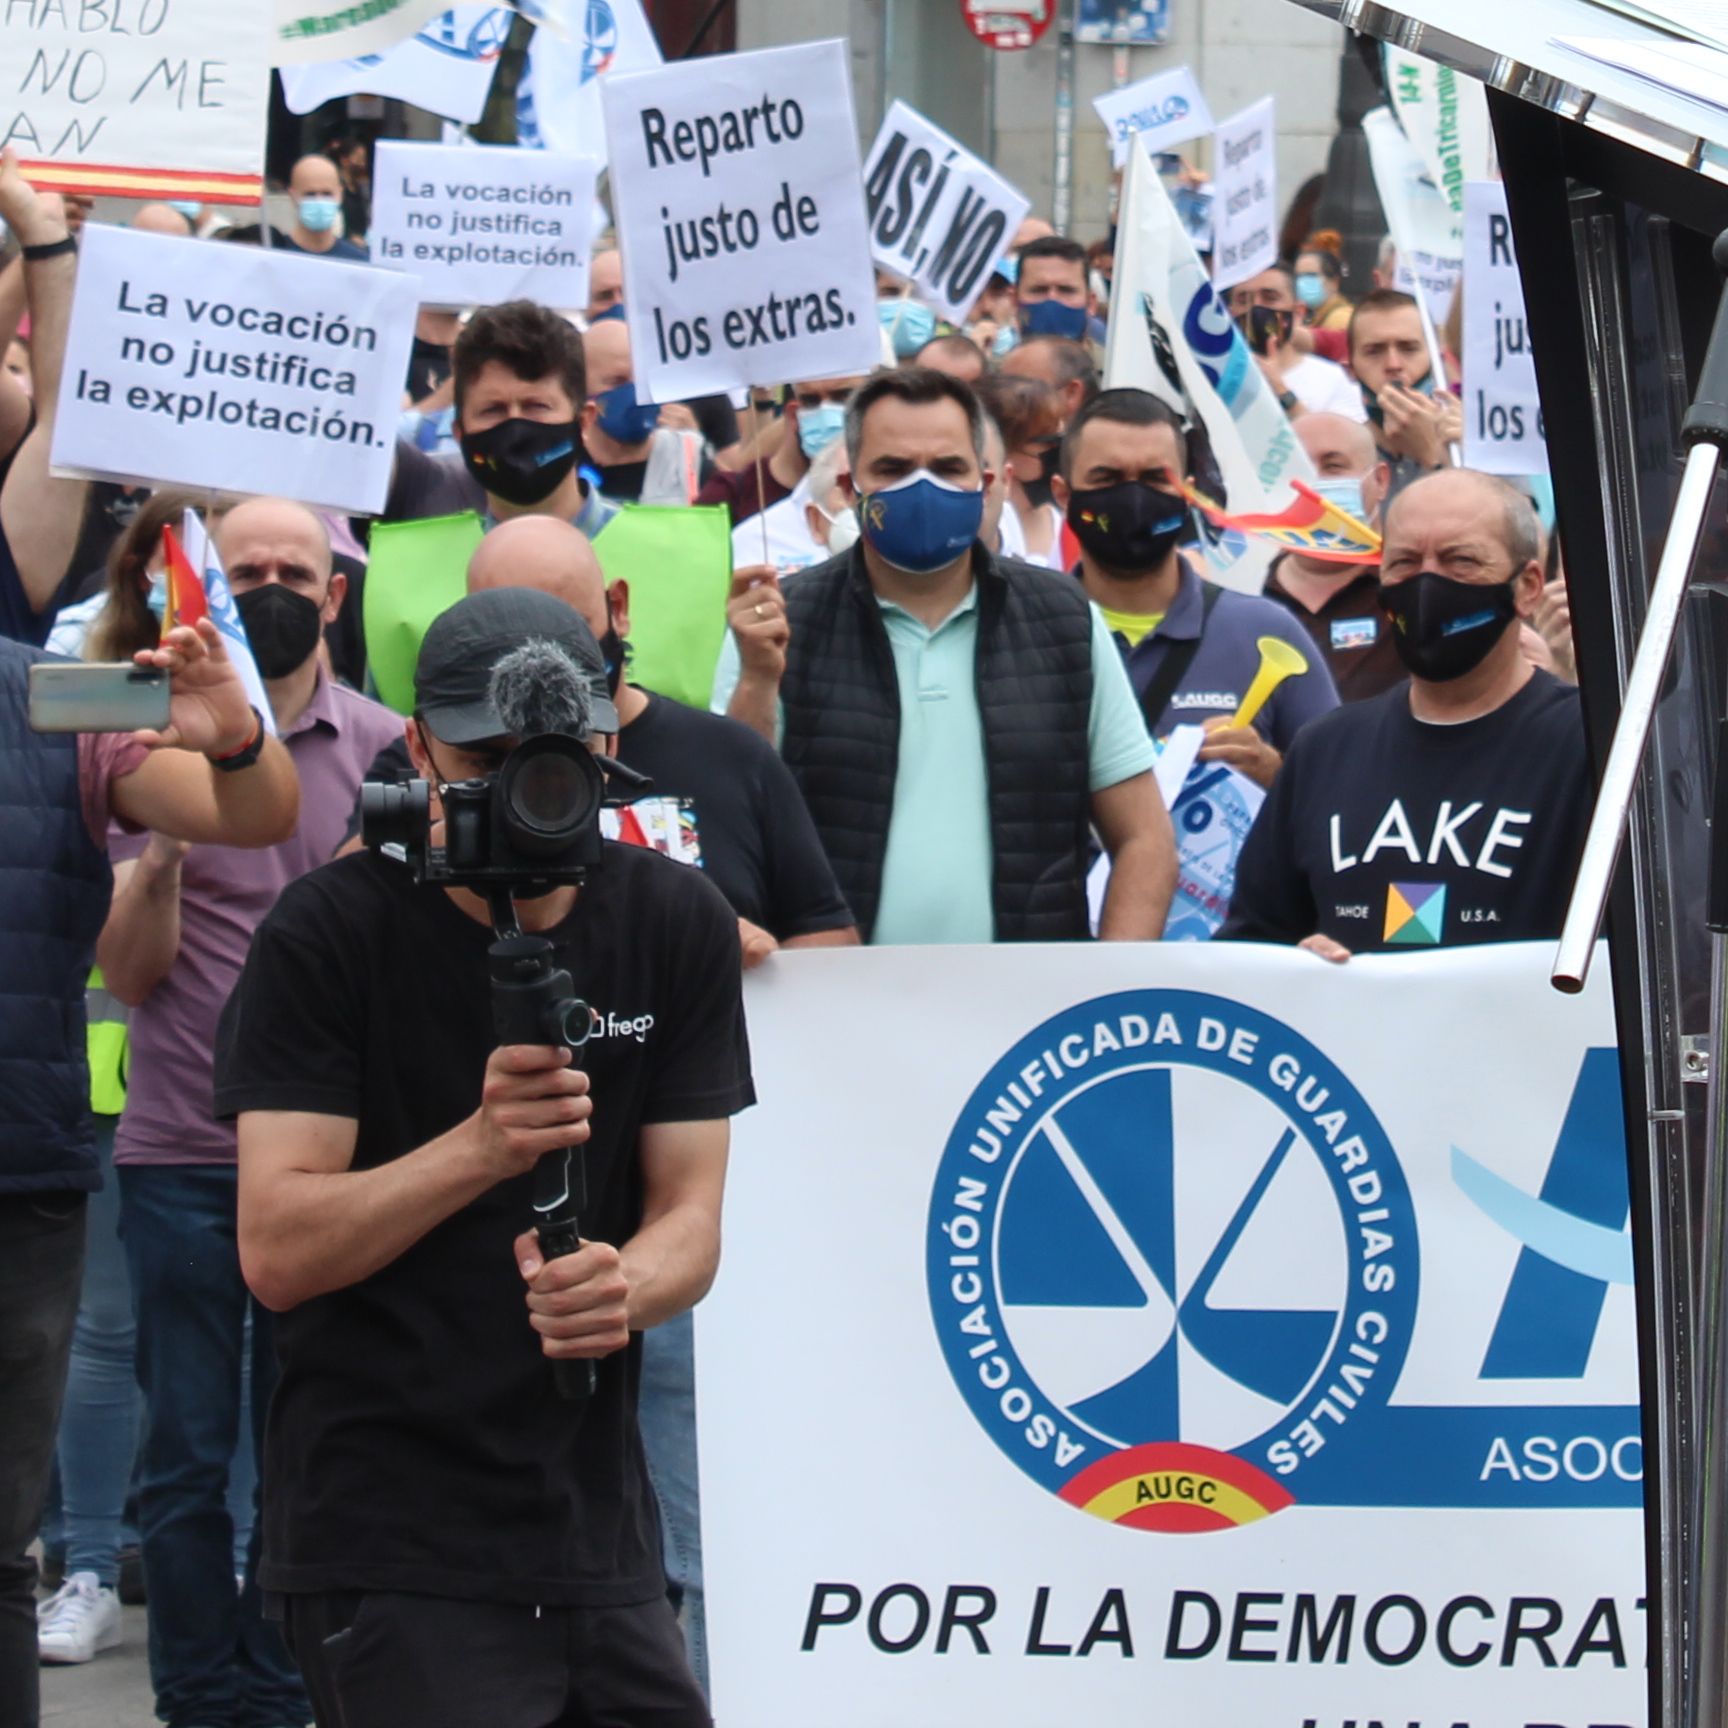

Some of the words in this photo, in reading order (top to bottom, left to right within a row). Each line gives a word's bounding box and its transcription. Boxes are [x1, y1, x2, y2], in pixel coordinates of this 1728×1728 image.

[18, 48, 106, 104] NO
[129, 58, 227, 110] ME
[643, 94, 805, 178] Reparto
[401, 175, 437, 200] La
[445, 177, 573, 206] vocación
[406, 213, 443, 231] no
[449, 209, 563, 240] justifica
[380, 237, 408, 259] la
[413, 237, 584, 270] explotación.
[660, 198, 761, 282] justo
[770, 183, 821, 239] de
[927, 185, 1006, 305] NO
[117, 280, 176, 323] La
[184, 294, 378, 353] vocación
[653, 308, 712, 364] los
[721, 286, 857, 350] extras.
[119, 335, 175, 369] no
[184, 337, 358, 396] justifica
[76, 370, 114, 405] la
[120, 379, 386, 451] explotación.
[1477, 388, 1525, 441] los
[1328, 797, 1532, 878] LAKE
[1334, 904, 1370, 921] TAHOE
[1197, 1016, 1260, 1065] DE
[969, 1011, 1183, 1165] UNIFICADA
[1269, 1052, 1396, 1294] GUARDIAS
[941, 1176, 1085, 1470] ASOCIACIÓN
[1266, 1310, 1390, 1476] CIVILES
[1135, 1475, 1217, 1506] AUGC
[799, 1582, 999, 1655] POR
[1023, 1586, 1136, 1661] LA
